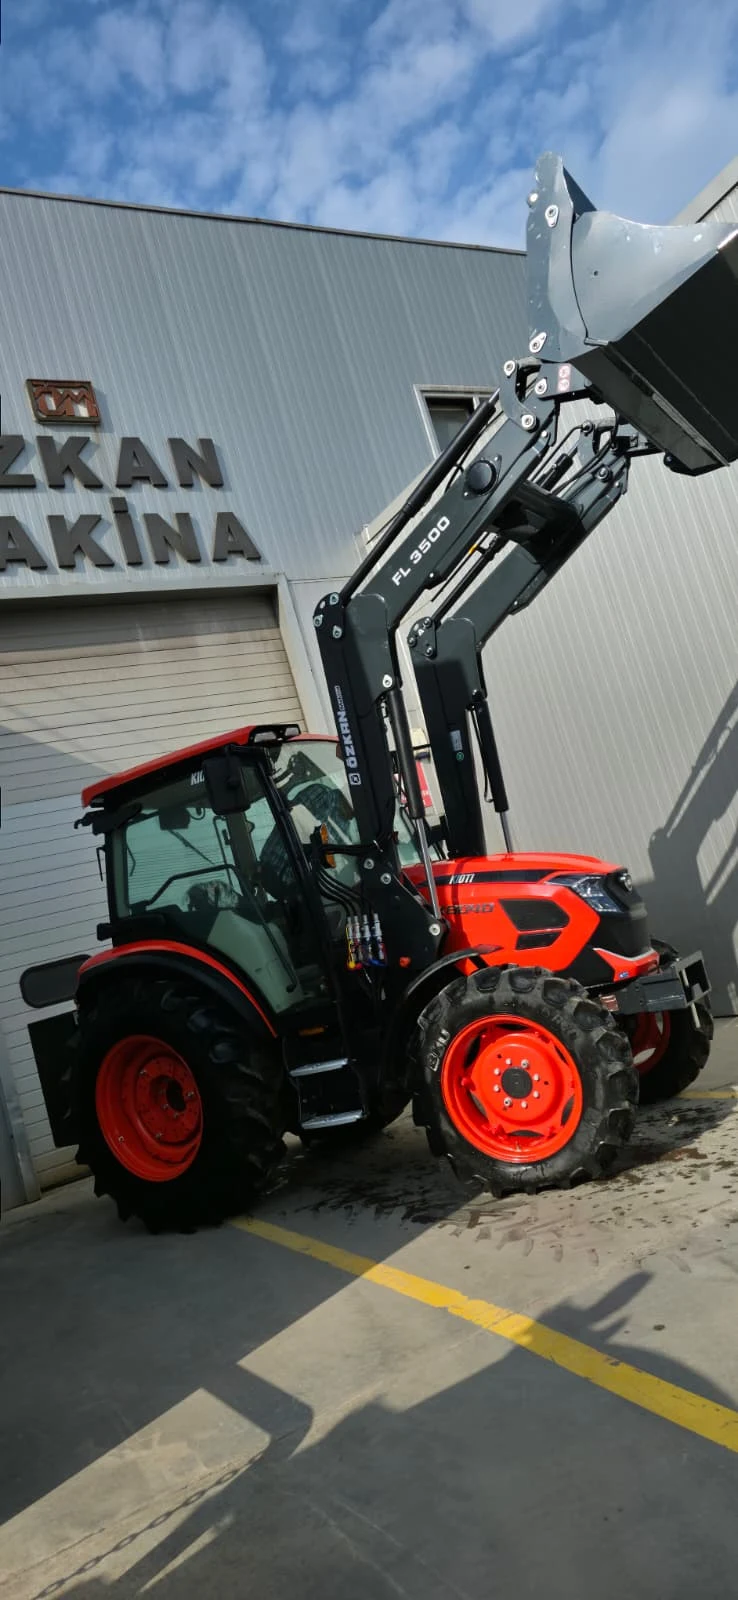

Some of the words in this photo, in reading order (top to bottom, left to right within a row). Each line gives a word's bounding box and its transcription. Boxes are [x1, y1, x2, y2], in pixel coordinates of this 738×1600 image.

[391, 567, 412, 587] FL
[409, 515, 451, 565] 3500
[448, 873, 476, 885] KIOTI
